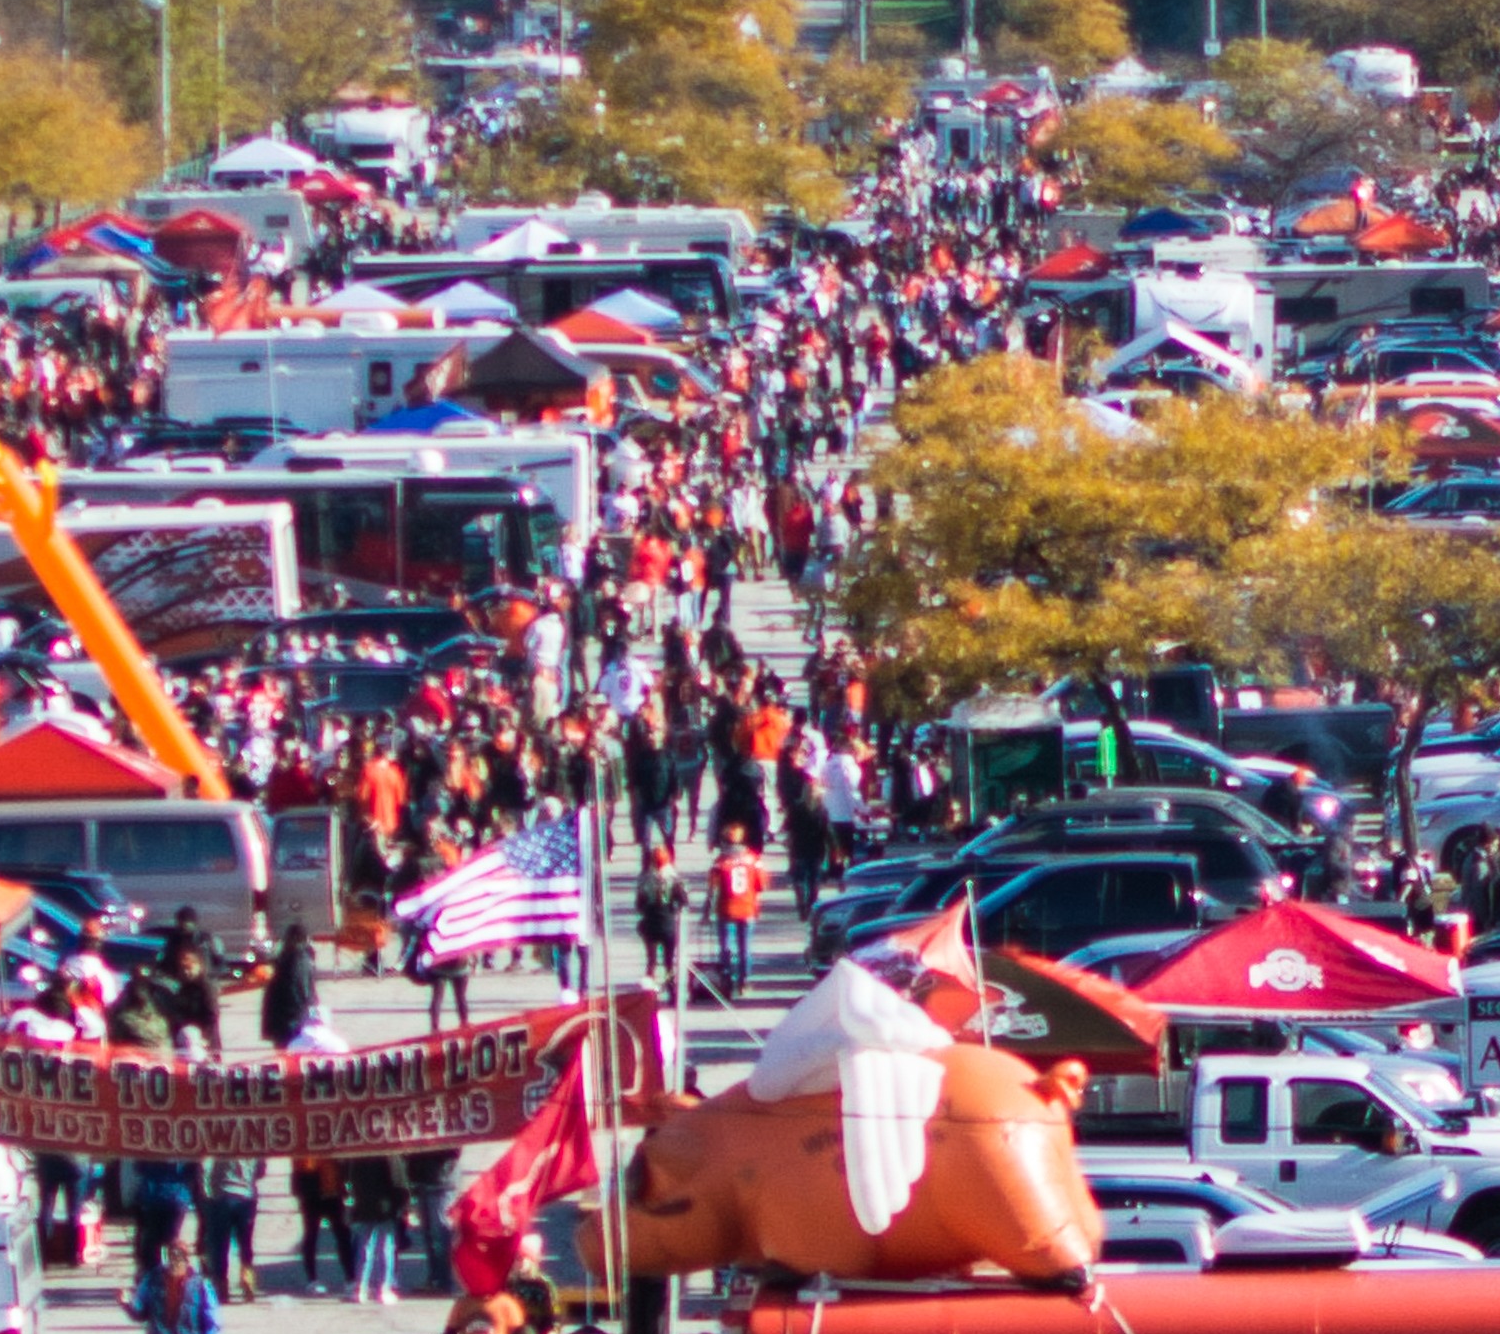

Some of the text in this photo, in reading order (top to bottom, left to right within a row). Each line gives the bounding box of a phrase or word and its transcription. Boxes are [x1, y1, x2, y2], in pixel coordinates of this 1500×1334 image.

[111, 1057, 175, 1109] TO
[189, 1058, 288, 1108] THE
[301, 1043, 430, 1103] MUNI
[442, 1024, 531, 1089] LOT
[30, 1103, 109, 1144] LOT
[119, 1111, 297, 1154] BROWNS
[304, 1086, 493, 1150] BACKERS
